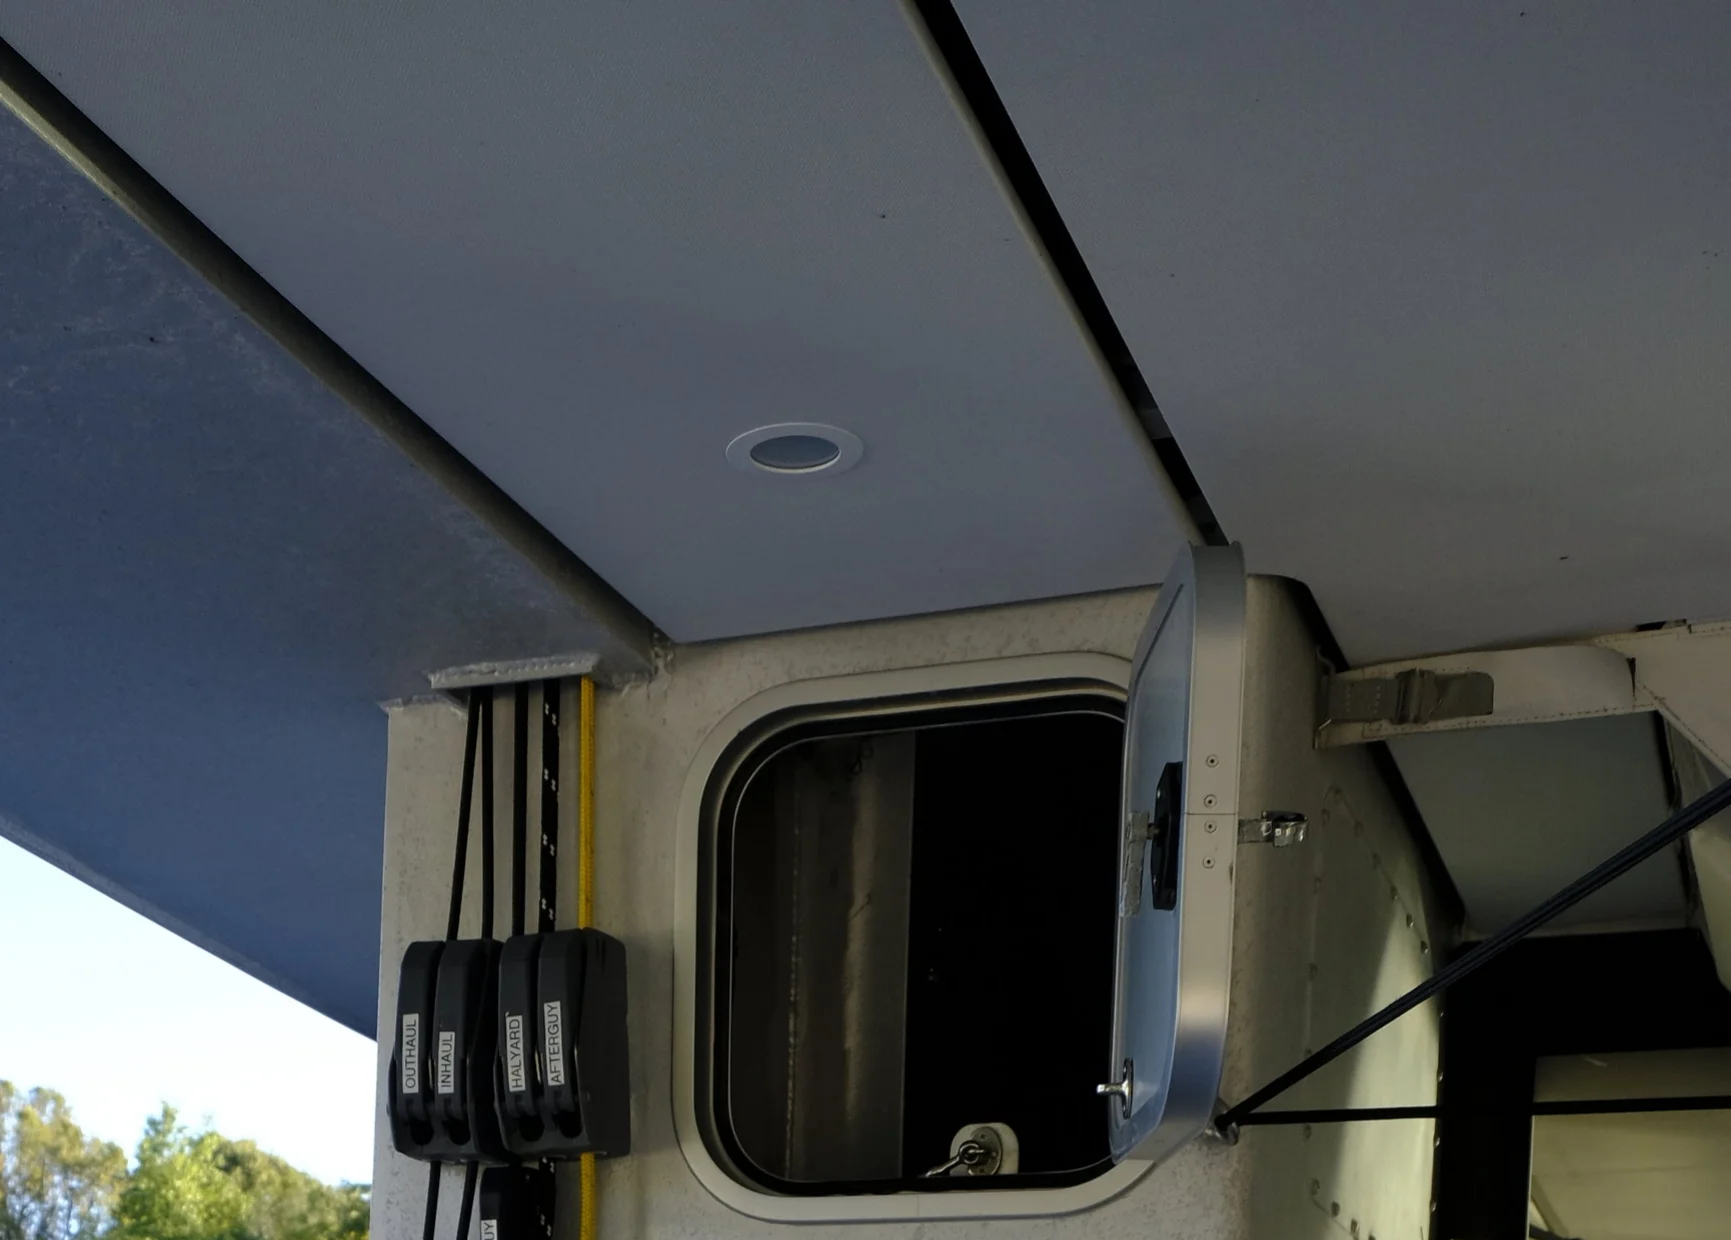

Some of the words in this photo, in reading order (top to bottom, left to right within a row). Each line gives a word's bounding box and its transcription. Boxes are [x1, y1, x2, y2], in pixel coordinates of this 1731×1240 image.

[405, 1018, 417, 1089] OUTHAUL
[441, 1033, 453, 1088] INHAUL
[509, 1018, 523, 1088] HALYARD
[547, 1004, 562, 1083] AFTERGUY
